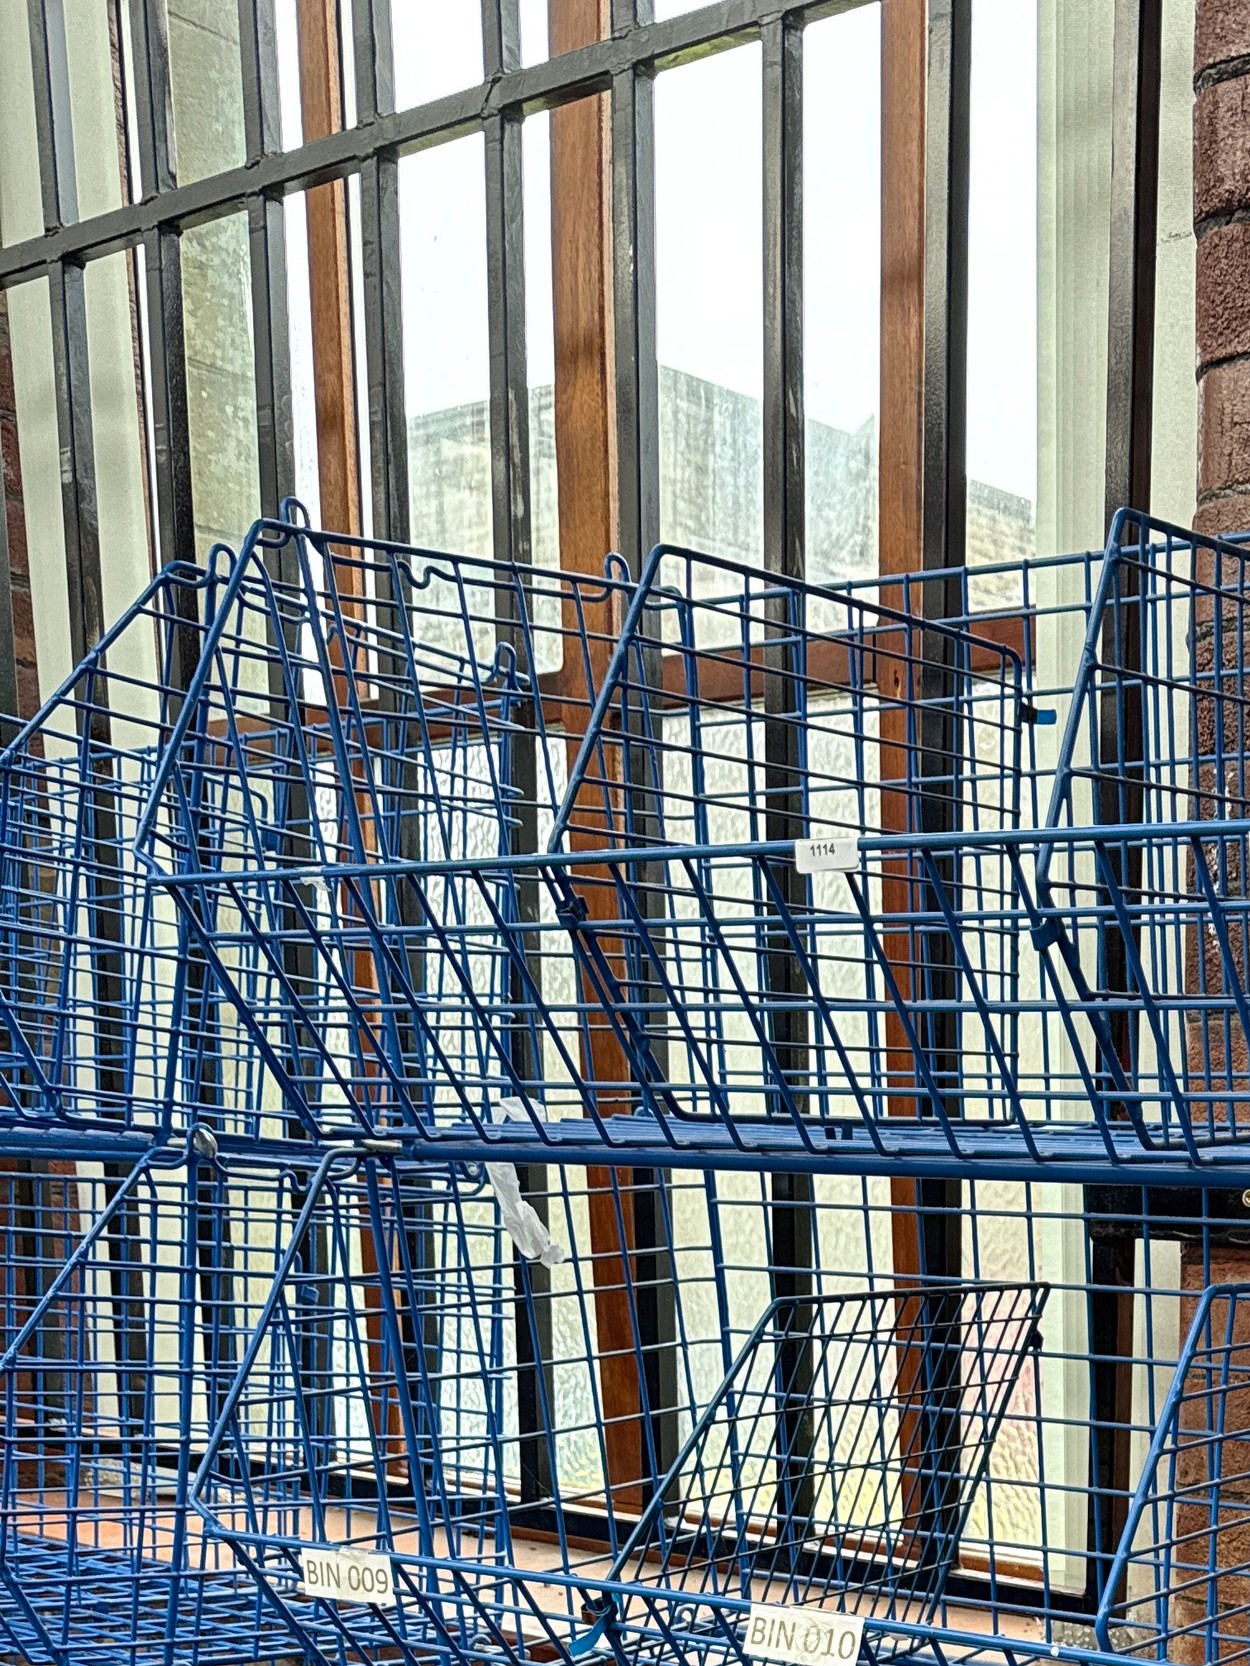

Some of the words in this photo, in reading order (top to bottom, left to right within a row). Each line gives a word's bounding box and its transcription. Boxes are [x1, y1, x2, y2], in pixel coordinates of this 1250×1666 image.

[810, 843, 836, 857] 1114
[306, 1560, 341, 1588] BIN
[348, 1565, 388, 1594] 009
[750, 1616, 796, 1650] BIN
[803, 1624, 856, 1659] 010
